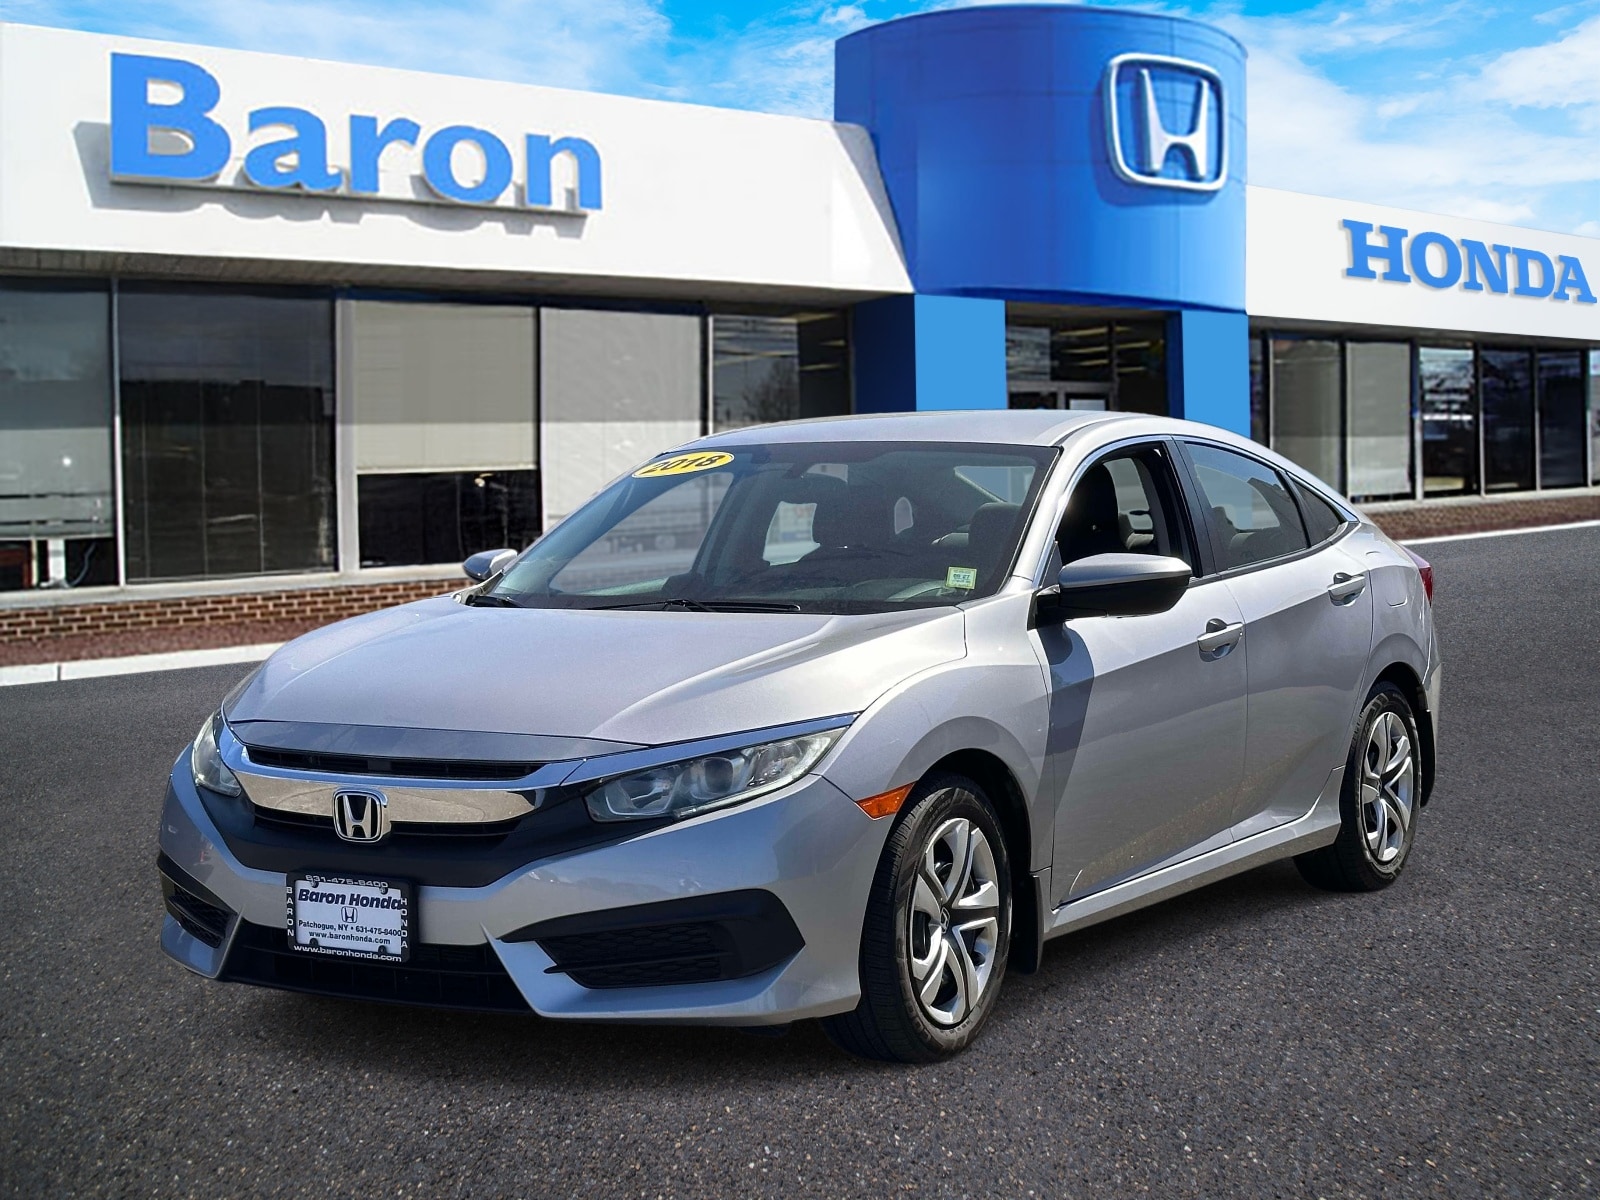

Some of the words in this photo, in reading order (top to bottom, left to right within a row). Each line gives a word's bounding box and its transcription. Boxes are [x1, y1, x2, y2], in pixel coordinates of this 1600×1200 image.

[110, 52, 603, 211] Baron
[1342, 218, 1598, 304] HONDA
[639, 455, 726, 475] 2018
[298, 888, 347, 905] Baron
[349, 893, 402, 910] Honda
[286, 886, 295, 937] BARON
[337, 924, 349, 932] NY
[400, 897, 408, 949] HONDA
[308, 930, 391, 945] www.baronhonda.com
[293, 945, 402, 962] www.baronhonda.com
